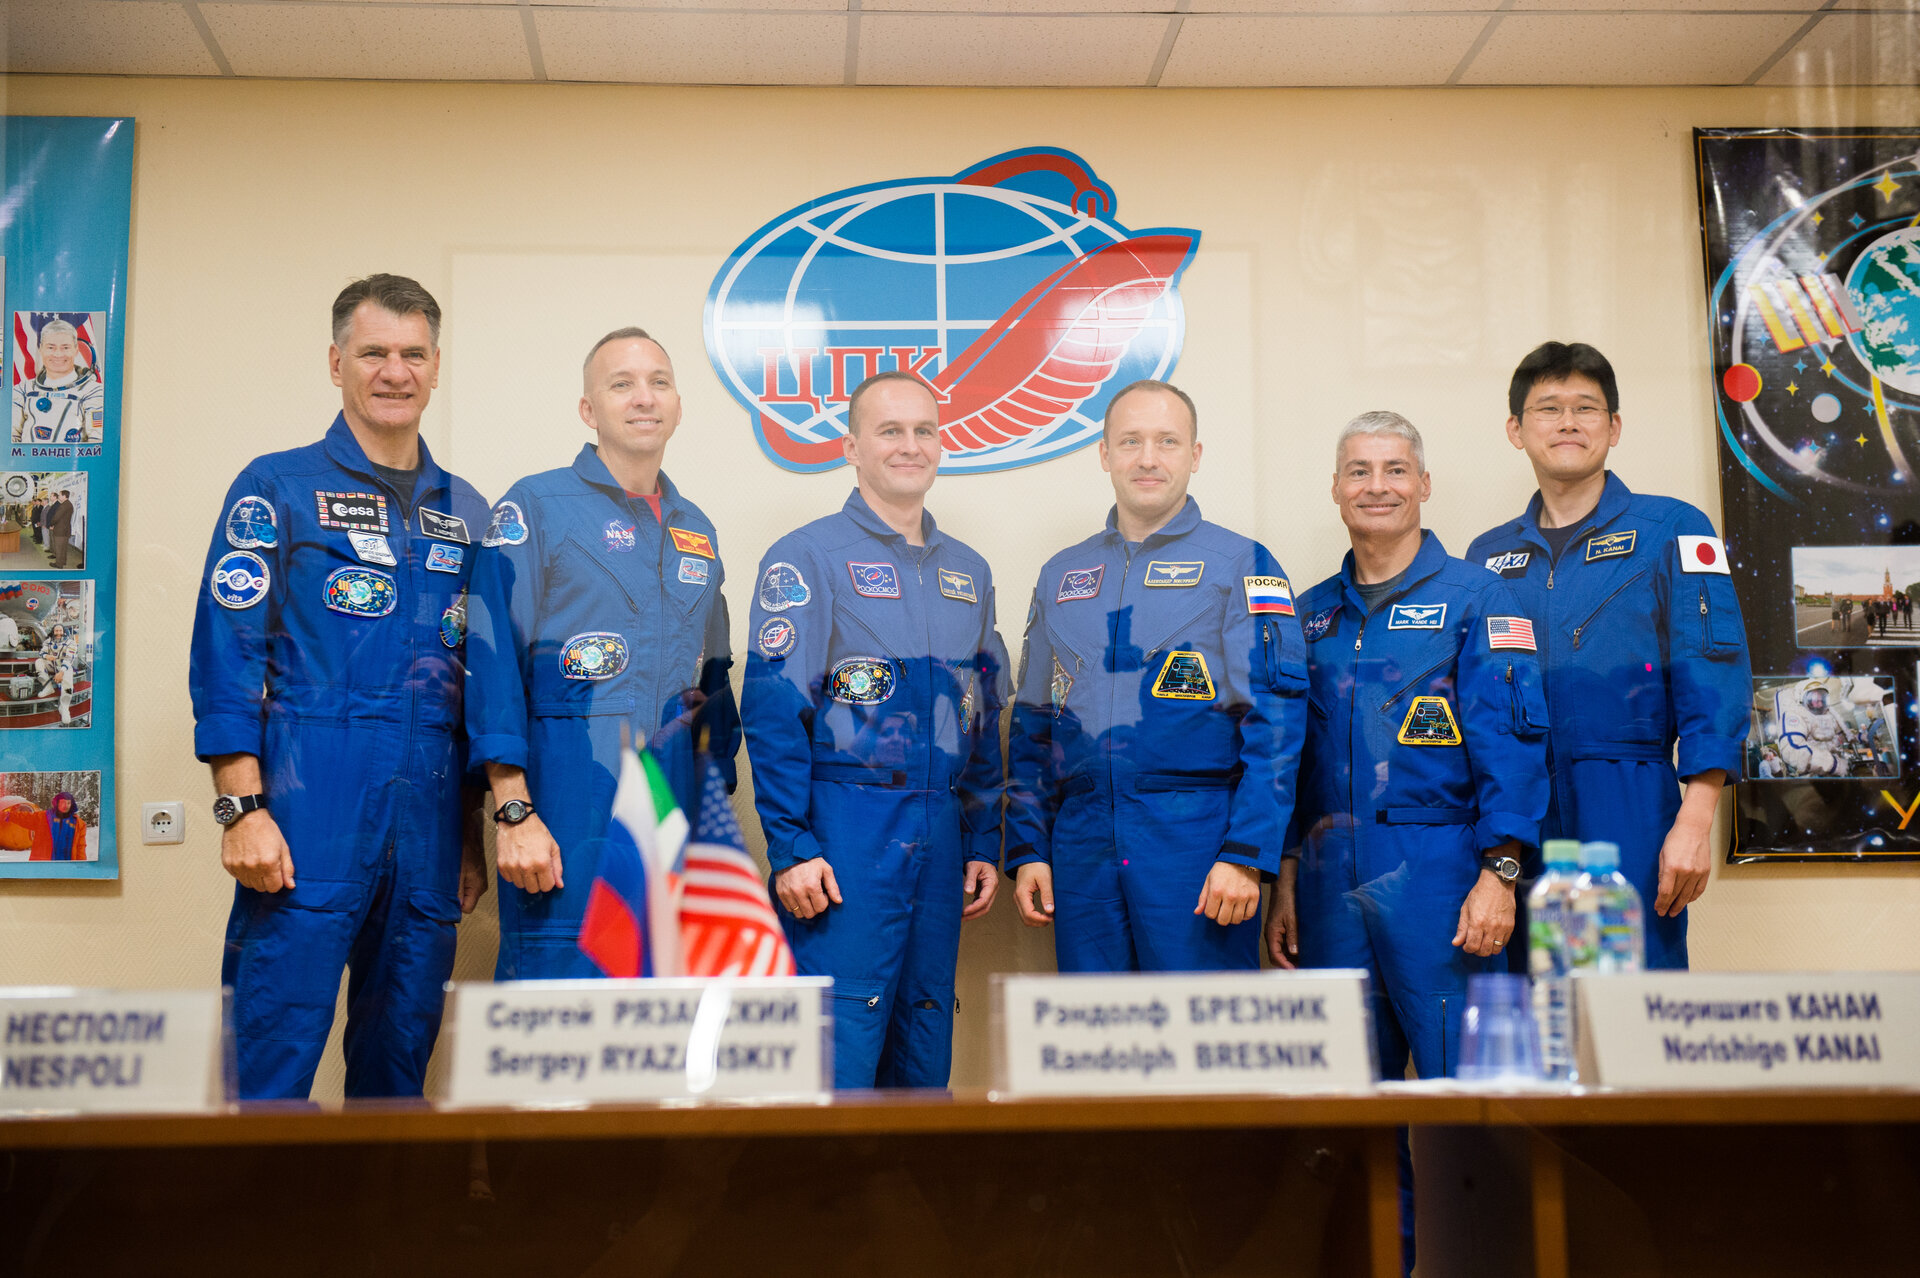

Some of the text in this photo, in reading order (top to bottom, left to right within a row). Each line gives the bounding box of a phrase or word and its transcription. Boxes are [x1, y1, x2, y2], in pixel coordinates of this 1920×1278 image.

[757, 346, 951, 414] ЦПК
[11, 445, 102, 458] М. ВАНДЕ ХАЙ
[348, 506, 375, 517] esa
[605, 530, 636, 541] NASA
[1603, 545, 1625, 553] KANAI
[21, 582, 51, 596] СОЮЗ
[226, 593, 243, 602] vita
[1247, 578, 1288, 590] РОССИЯ
[487, 994, 799, 1033] Сергей РЯЗАСКИЙ
[1035, 996, 1328, 1029] Рэндолф БРЕЗНИК
[1645, 993, 1881, 1027] Норишиге КАНАИ
[7, 1012, 166, 1043] НЕСПОЛИ
[487, 1044, 797, 1081] Sergey RYAZSKIY
[1041, 1043, 1328, 1079] Randolph BRESNIK
[1663, 1034, 1881, 1069] Norishige KANAI
[4, 1055, 142, 1088] NESPOLI
